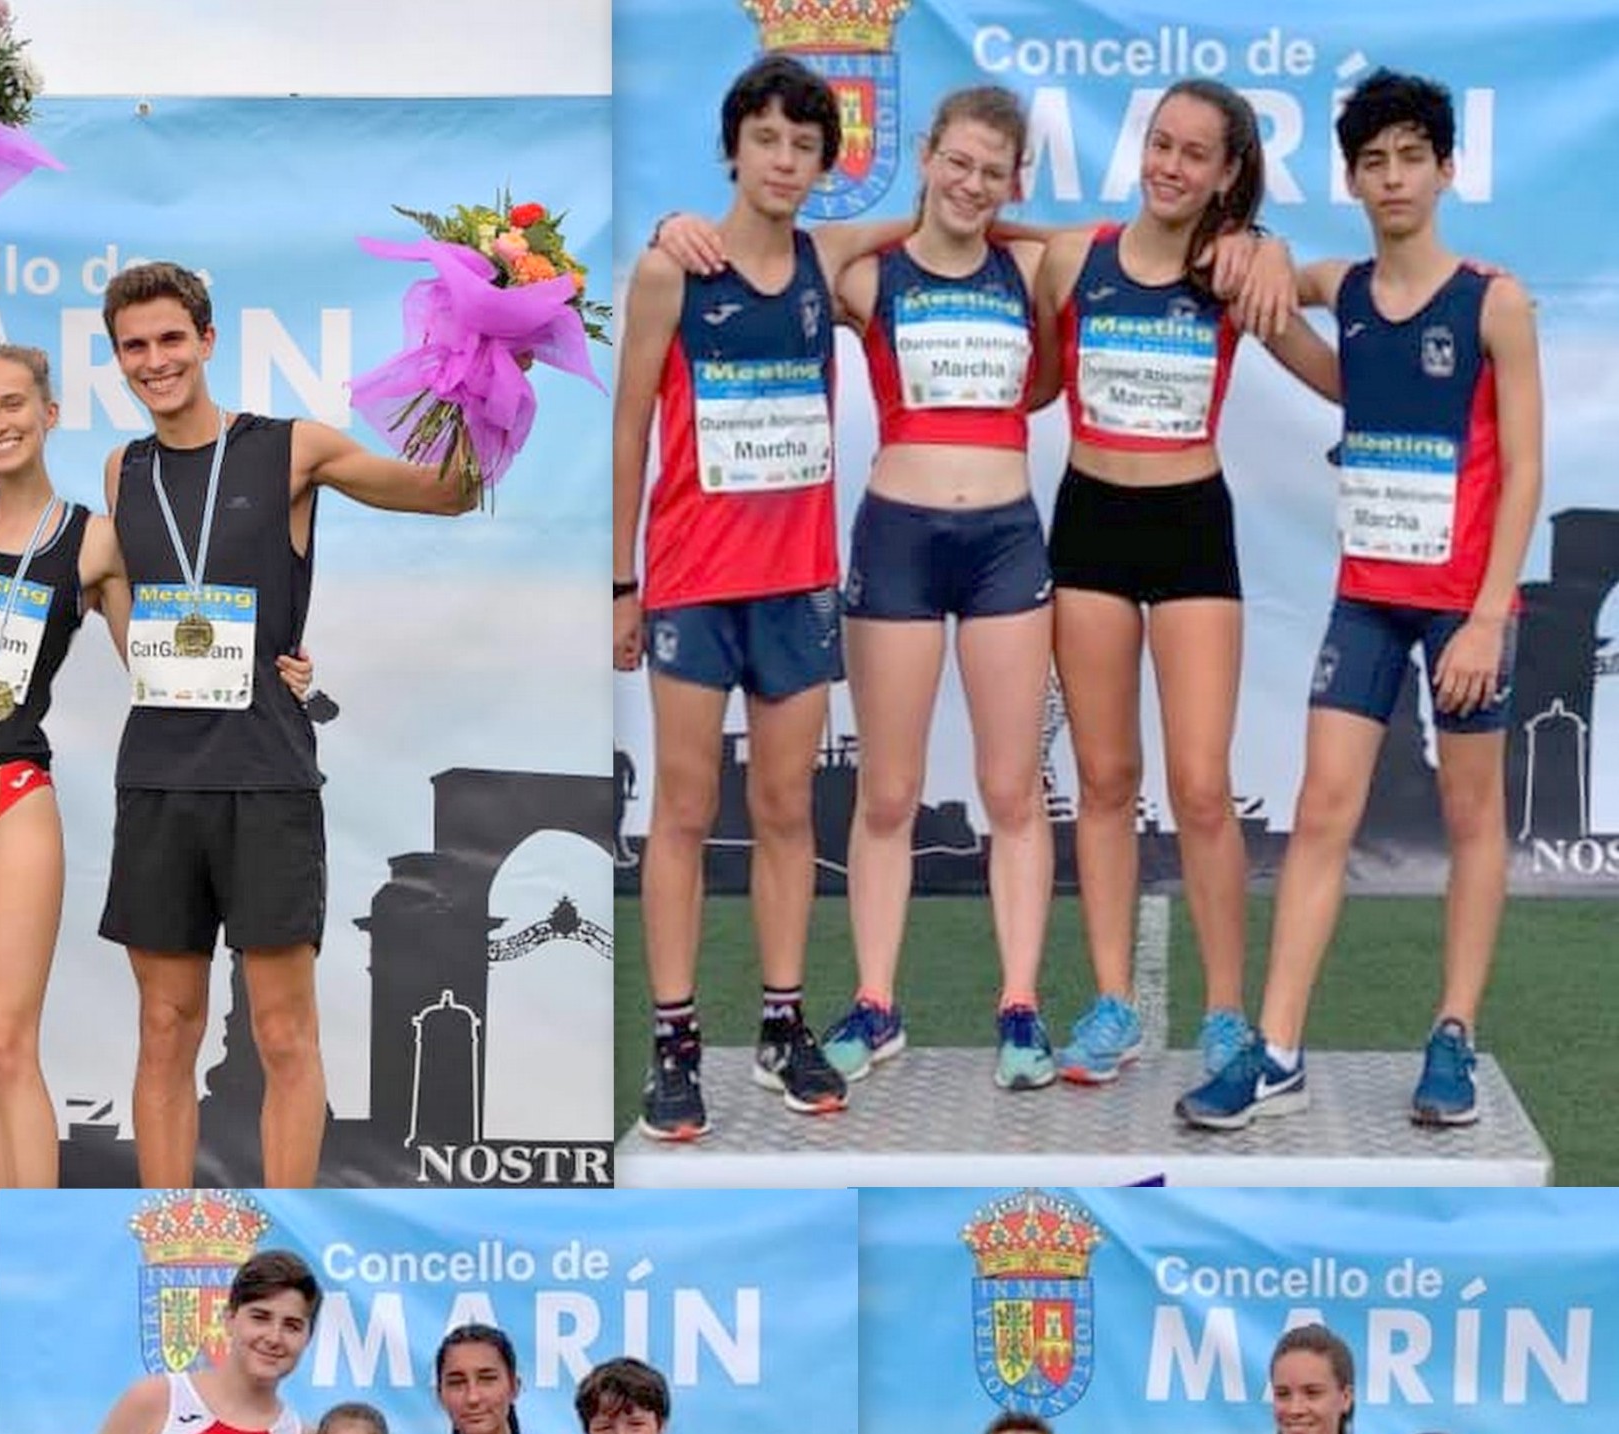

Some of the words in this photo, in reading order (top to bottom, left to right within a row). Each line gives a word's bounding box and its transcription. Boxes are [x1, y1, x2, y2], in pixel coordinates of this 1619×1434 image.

[973, 25, 1227, 77] Concello
[1247, 27, 1315, 76] de
[931, 359, 1005, 378] Marcha
[734, 441, 807, 459] Marcha
[1355, 509, 1420, 532] Marcha
[417, 1145, 614, 1183] NOSTR
[323, 1240, 536, 1283] Concello
[552, 1240, 609, 1281] de
[1155, 1255, 1369, 1298] Concello
[1386, 1256, 1442, 1298] de
[1146, 1277, 1593, 1405] MRÍN
